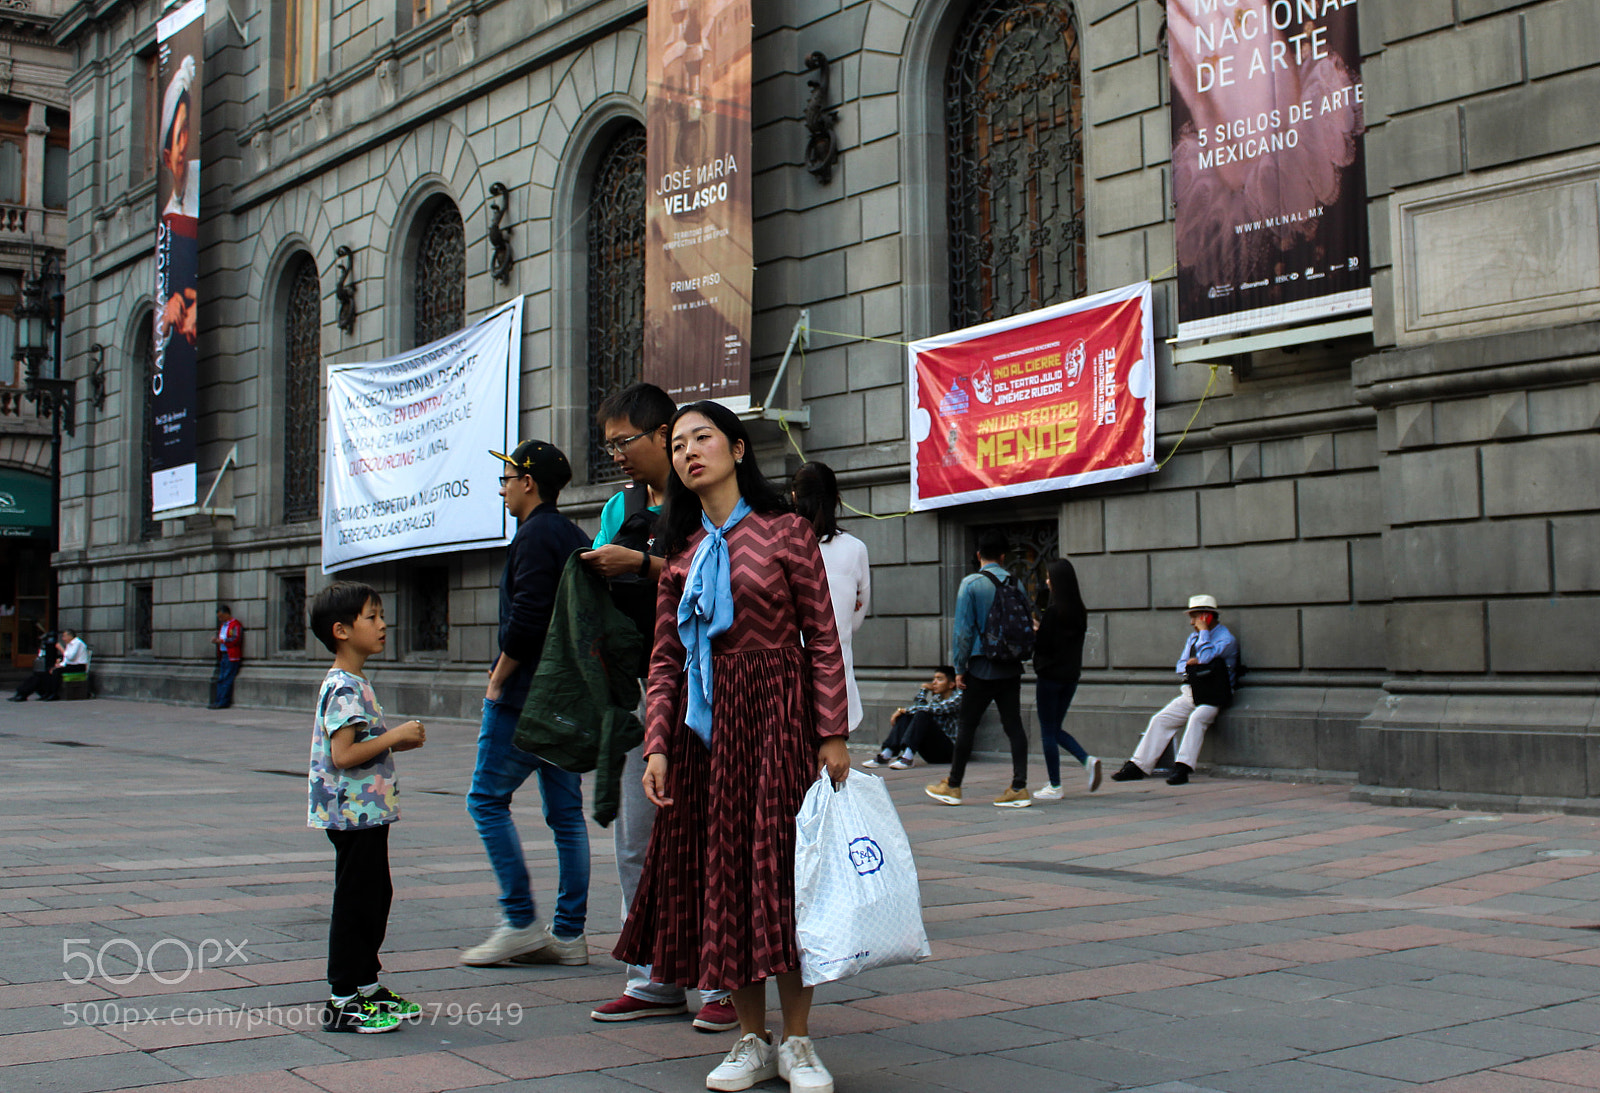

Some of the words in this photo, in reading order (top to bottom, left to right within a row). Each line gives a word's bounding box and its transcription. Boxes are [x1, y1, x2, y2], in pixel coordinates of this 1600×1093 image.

[1197, 56, 1236, 93] DE
[1248, 26, 1329, 79] ARTE
[1198, 128, 1208, 148] 5
[1215, 109, 1281, 143] SIGLOS
[1289, 100, 1313, 124] DE
[1320, 83, 1364, 116] ARTE
[1198, 129, 1298, 170] MEXICANO
[656, 164, 691, 196] JOSÉ
[664, 182, 728, 216] VELASCO
[1347, 256, 1359, 268] 30
[702, 272, 720, 287] PISO
[1010, 363, 1025, 376] AL
[1025, 353, 1062, 373] CIERRE
[1104, 347, 1116, 397] ARTE
[994, 382, 1009, 393] DEL
[1009, 374, 1040, 389] TEATRO
[1040, 369, 1063, 383] JULIO
[1031, 382, 1063, 398] RUEDA!
[394, 408, 406, 424] EN
[1000, 412, 1020, 431] UN
[1021, 400, 1079, 427] TEATRO
[1105, 398, 1116, 425] DE
[976, 418, 1078, 470] MENOS
[349, 449, 416, 477] OUTSOURCING
[417, 479, 470, 506] NUESTROS
[851, 846, 878, 867] C&A
